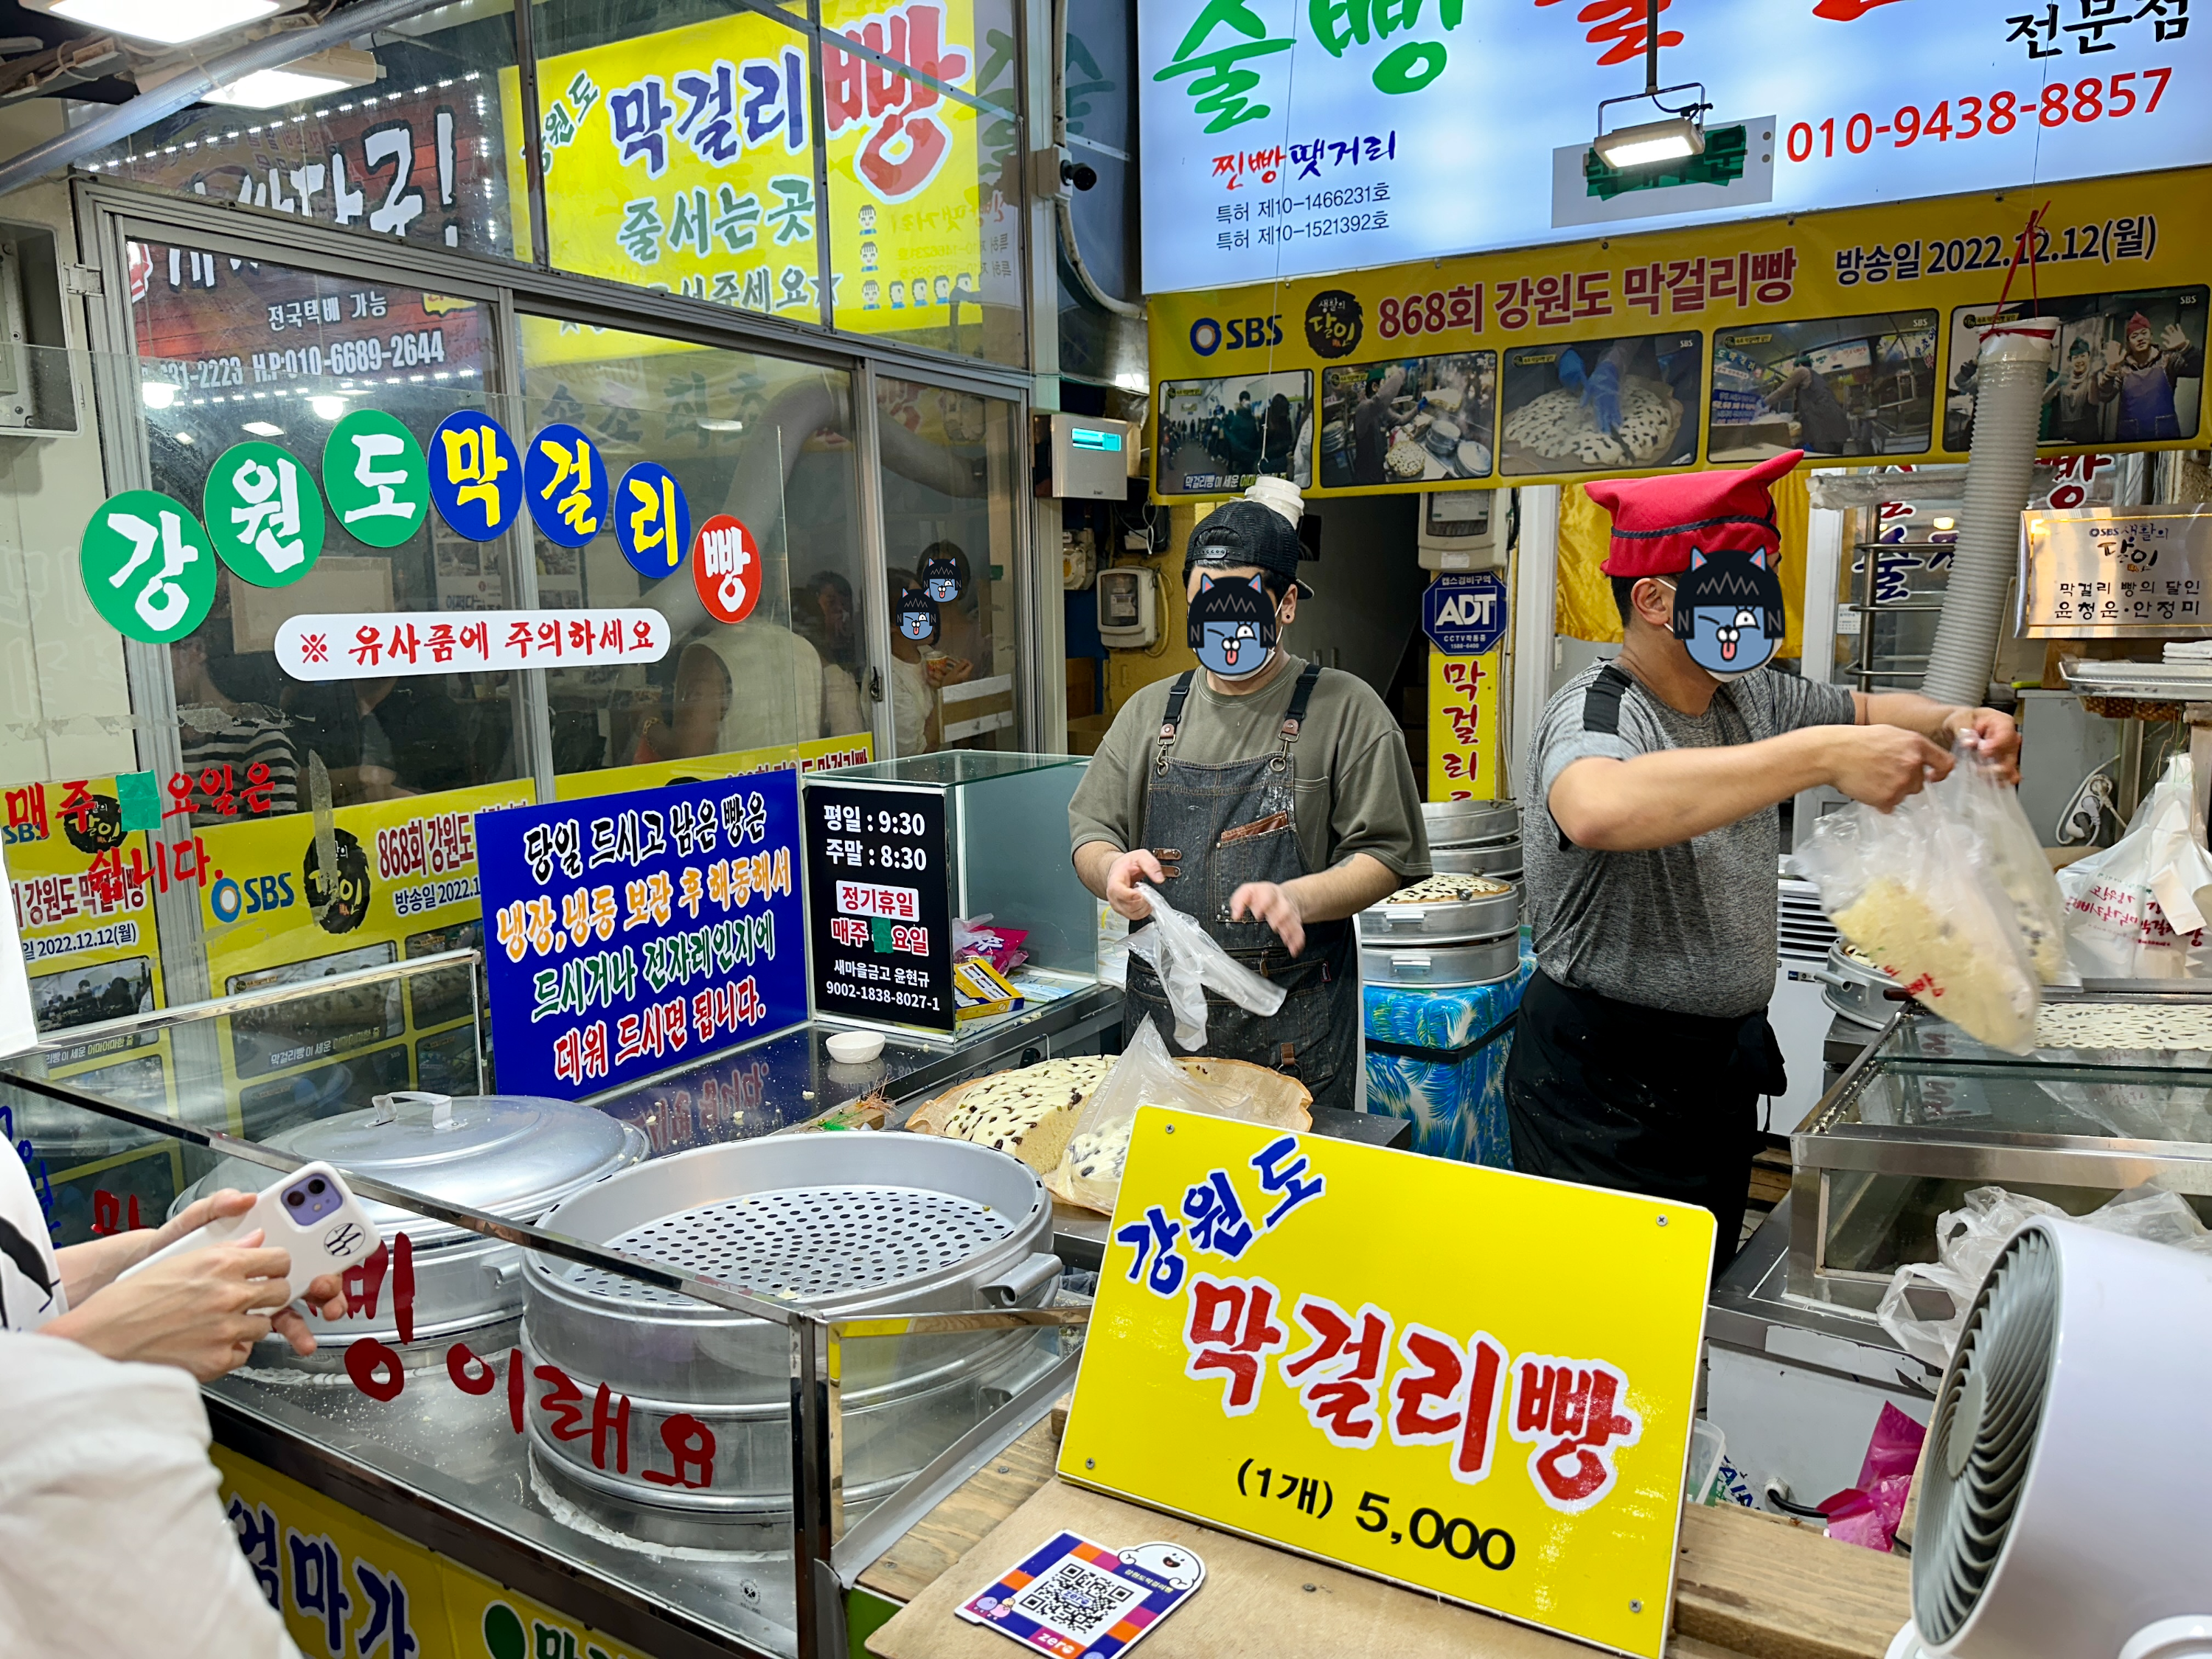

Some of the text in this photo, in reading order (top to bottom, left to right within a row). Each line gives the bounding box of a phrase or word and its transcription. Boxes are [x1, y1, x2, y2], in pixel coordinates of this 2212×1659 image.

[2005, 0, 2189, 59] 전문점
[1787, 67, 2172, 162] 010-9438-8857
[1212, 145, 1287, 190] 찐빵
[1216, 182, 1391, 224] 특허 제10-1466231호
[1216, 210, 1390, 251] 특허 제10-1521392호
[1836, 215, 2157, 285] 방송일 2022.12.12(월)
[650, 266, 808, 311] 서주세요
[1318, 297, 1346, 313] 생활의
[1378, 247, 1797, 341] 868회 강원도 막걸리빵
[2180, 295, 2197, 305] SBS
[268, 292, 386, 330] 전국택배 가능
[1226, 314, 1283, 350] SBS
[1309, 313, 1355, 347] 달인
[1913, 319, 1927, 327] SBS
[1680, 339, 1693, 348] SBS
[2101, 523, 2168, 541] SBS 생활의
[2059, 580, 2199, 597] 막걸리 빵의 달인
[1435, 594, 1497, 626] ADT
[347, 616, 655, 666] 유사품에 주의하세요
[1442, 659, 1486, 801] 막걸리
[5, 780, 97, 838] 매주
[824, 804, 861, 832] 평일
[878, 811, 925, 835] 9:30
[379, 813, 474, 877] 868회 강원도
[526, 793, 765, 883] 당일 드시고 남은 빵은
[826, 838, 863, 867] 주말
[880, 846, 927, 871] 8:30
[88, 837, 223, 904] 쉽니다.
[24, 875, 78, 925] 강원도
[244, 872, 294, 914] SBS
[395, 885, 435, 914] 방송일
[498, 848, 791, 959] 냉장,냉동 보관 후 해동해서
[842, 886, 914, 917] 정기휴일
[37, 922, 137, 957] 2022.12.12(월)
[831, 918, 869, 947] 매주
[532, 911, 773, 1022] 드시거나 전자레인지에
[834, 960, 930, 987] 새마을금고 윤현규
[826, 981, 940, 1011] 9002-1838-8027-1
[554, 976, 766, 1083] 데워 드시면 됩니다.
[1116, 1136, 1324, 1295] 강원도
[1189, 1282, 1632, 1500] 막걸리빵
[1237, 1458, 1517, 1571] (1개) 5,000
[1037, 1632, 1075, 1655] zero
